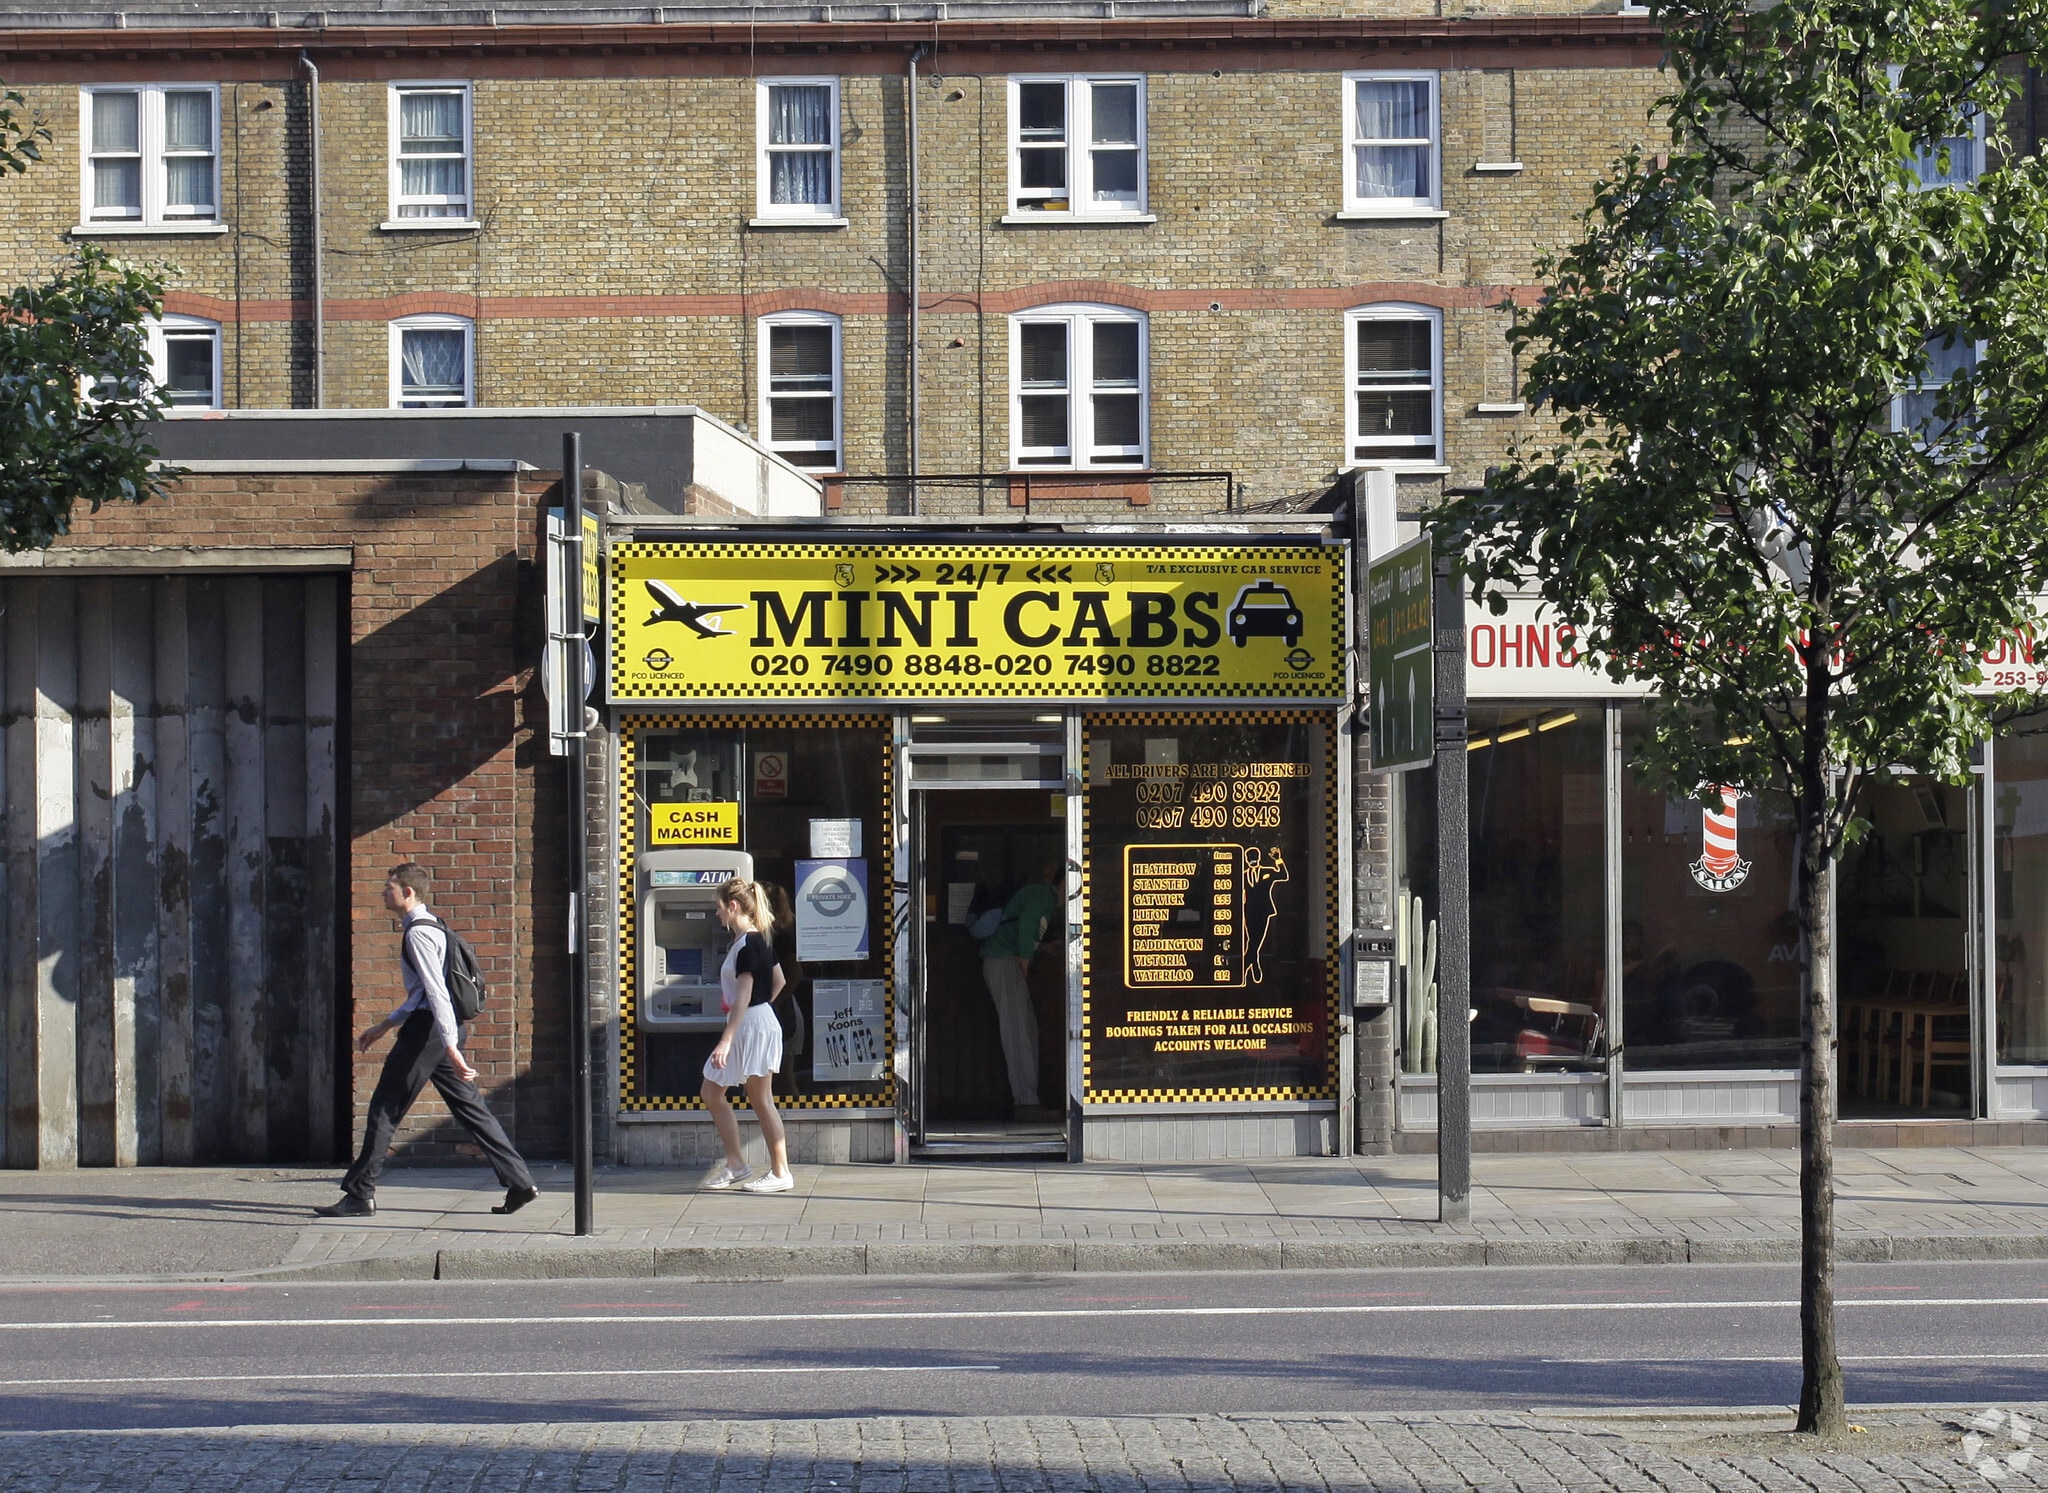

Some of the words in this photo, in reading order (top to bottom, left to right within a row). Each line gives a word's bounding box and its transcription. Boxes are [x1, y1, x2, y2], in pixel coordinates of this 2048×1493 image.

[1146, 564, 1167, 575] T/A
[1169, 564, 1238, 575] EXCLUSIVE
[1241, 564, 1267, 575] CAR
[1269, 564, 1322, 575] SERVICE
[936, 563, 1011, 590] 24/7
[749, 590, 979, 648] MINI
[1002, 590, 1222, 649] CABS
[1464, 624, 1578, 668] OHNS
[750, 654, 810, 677] 020
[821, 654, 893, 677] 7490
[1064, 654, 1136, 677] 7490
[1146, 654, 1221, 677] 8822
[631, 672, 648, 680] PCO
[649, 672, 685, 680] LICENCED
[1273, 672, 1290, 680] PCO
[1291, 672, 1326, 680] LICENCED
[1104, 765, 1130, 778] ALL
[1131, 765, 1189, 778] DRIVERS
[1192, 764, 1217, 778] ARE
[1221, 764, 1249, 777] PCO
[1250, 763, 1312, 777] LICENCED
[1136, 782, 1184, 803] 0207
[1190, 781, 1228, 803] 490
[1232, 781, 1281, 803] 8822
[669, 811, 719, 823] CASH
[1136, 806, 1185, 828] 0207
[1190, 806, 1228, 828] 490
[1232, 806, 1281, 828] 8848
[657, 827, 733, 840] MACHINE
[1213, 850, 1233, 860] from
[1132, 863, 1197, 876] HEATHROW
[699, 871, 733, 883] ATM
[1694, 869, 1746, 890] SALON
[1132, 878, 1190, 891] STANSTED
[1132, 893, 1185, 906] GATWICK
[1132, 909, 1169, 921] LUTON
[1132, 924, 1160, 936] CITY
[1132, 939, 1204, 951] PADDINGTON
[1132, 954, 1187, 967] VICTORIA
[1132, 969, 1194, 982] WATERLOO
[833, 1007, 853, 1020] Jeff
[1127, 1010, 1179, 1023] FRIENDLY
[1181, 1009, 1190, 1021] &
[1192, 1008, 1245, 1021] RELIABLE
[1248, 1007, 1293, 1020] SERVICE
[827, 1018, 864, 1032] Koons
[1105, 1025, 1163, 1038] BOOKINGS
[1165, 1024, 1201, 1037] TAKEN
[1204, 1024, 1227, 1036] FOR
[1229, 1023, 1250, 1036] ALL
[1252, 1022, 1314, 1035] OCCASIONS
[1154, 1039, 1211, 1052] ACCOUNTS
[1213, 1038, 1267, 1050] WELCOME
